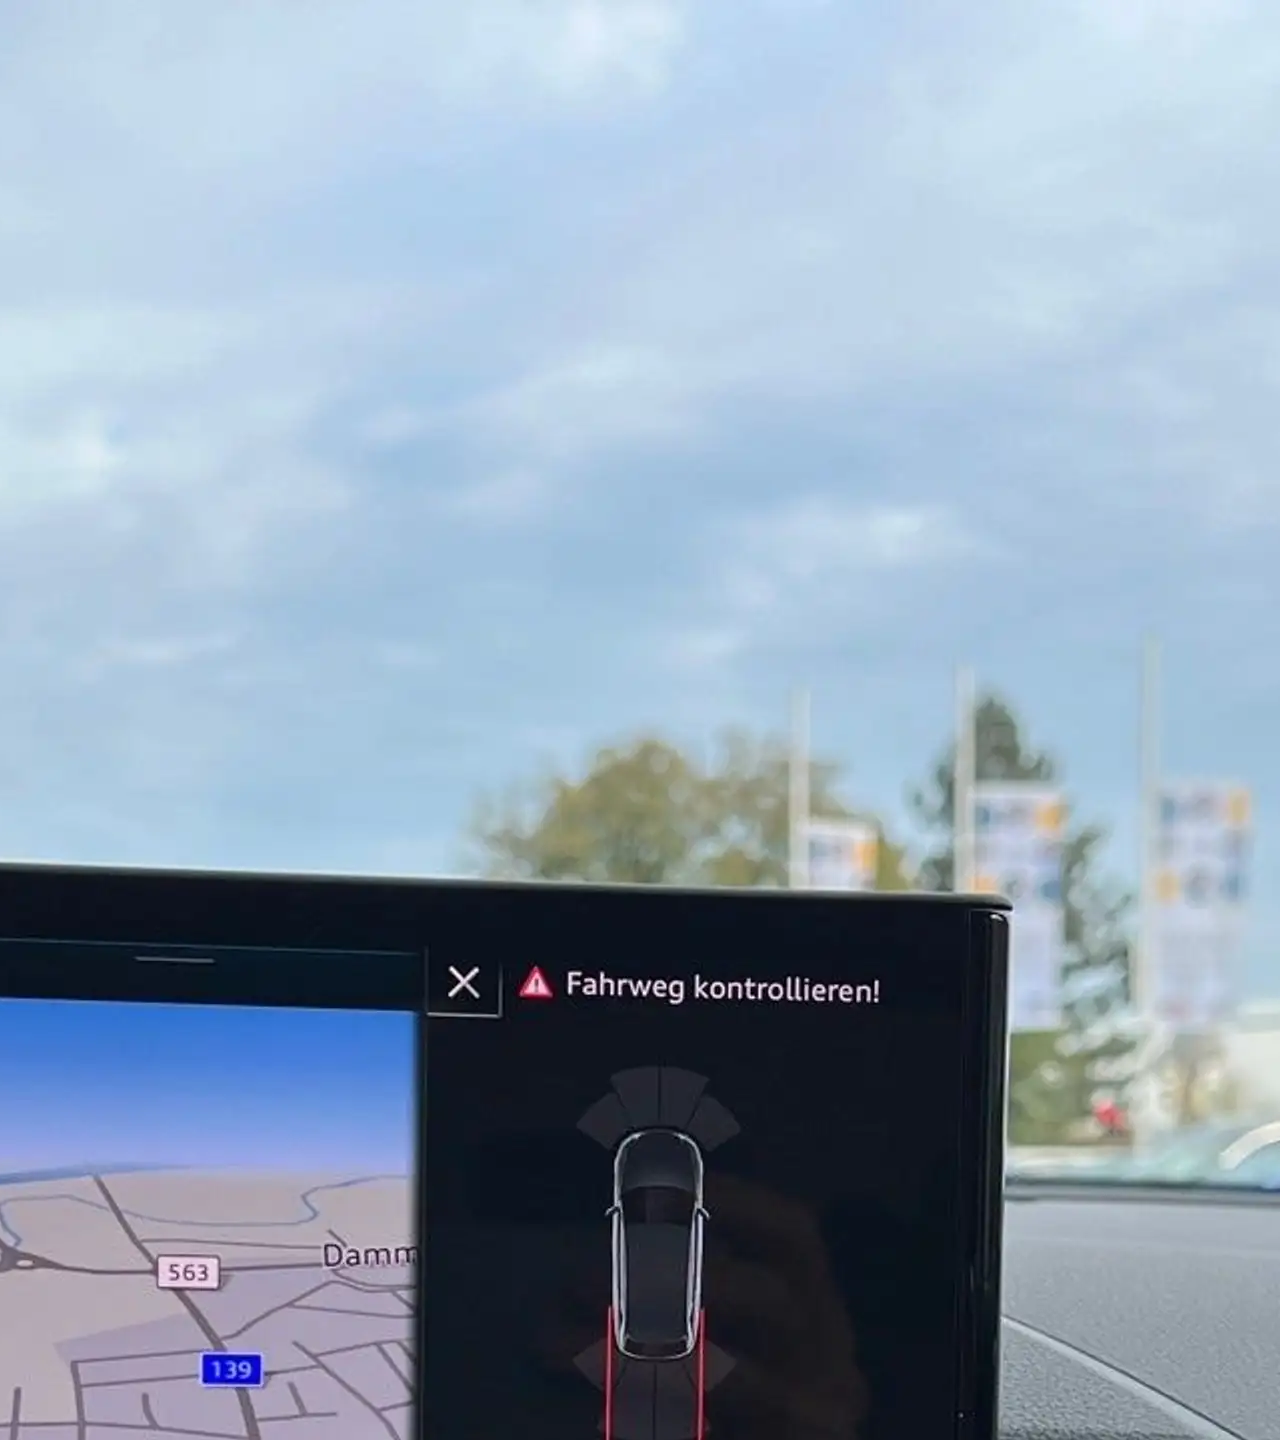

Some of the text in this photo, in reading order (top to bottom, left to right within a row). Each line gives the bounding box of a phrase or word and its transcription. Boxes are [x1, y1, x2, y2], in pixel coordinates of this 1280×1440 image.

[566, 971, 881, 1004] Fahrweg kontrollieren!
[168, 1262, 209, 1283] 563
[210, 1360, 252, 1380] 139
